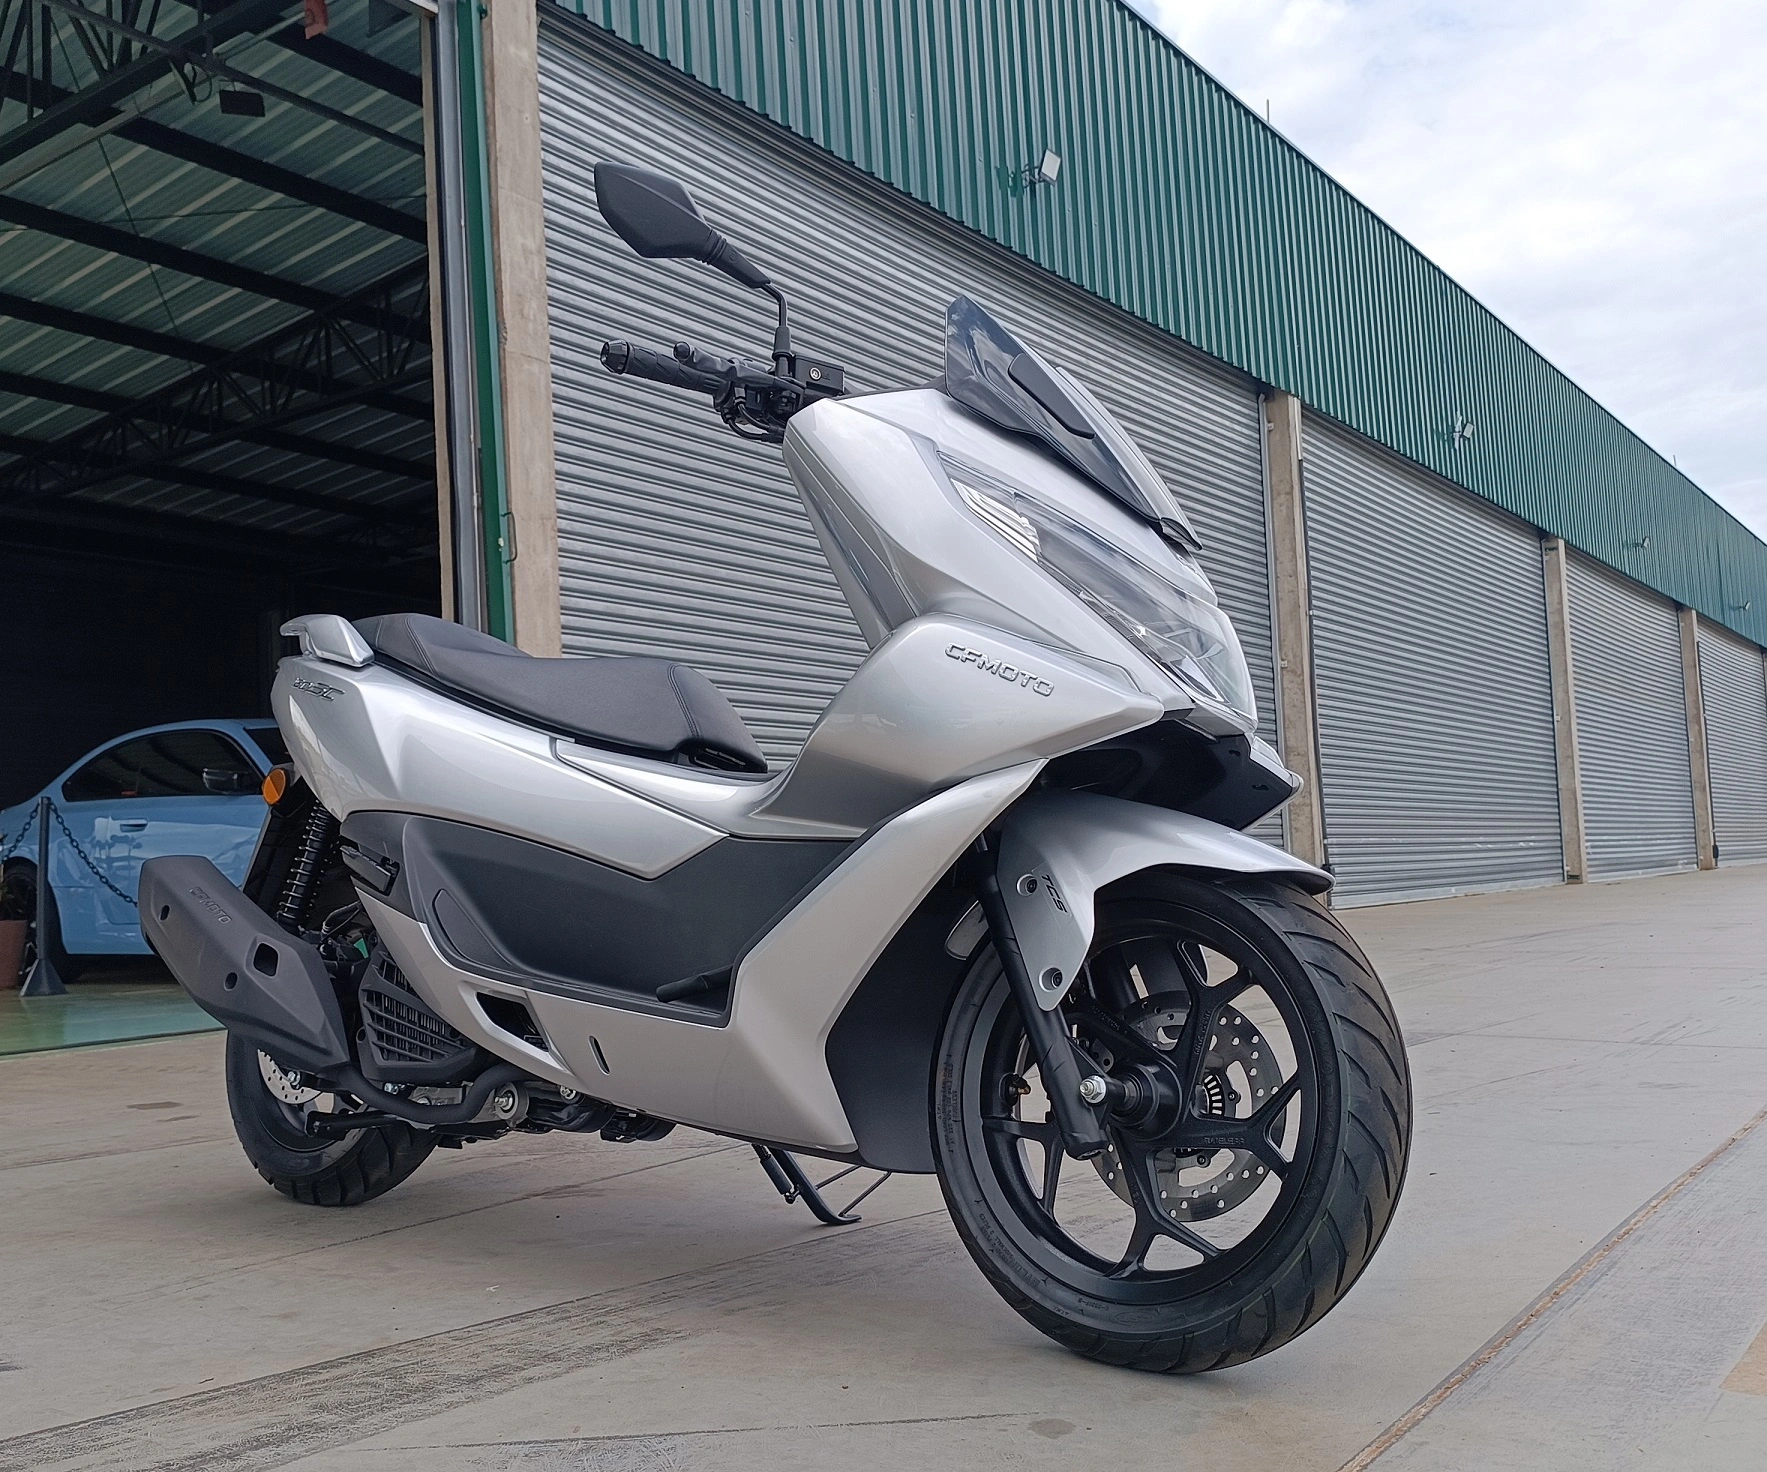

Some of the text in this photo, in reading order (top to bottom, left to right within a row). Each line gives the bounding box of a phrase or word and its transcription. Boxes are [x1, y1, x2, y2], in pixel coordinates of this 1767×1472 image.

[944, 642, 1055, 697] CFMOTO
[189, 886, 232, 924] CFMOTO
[1041, 874, 1068, 914] TCS
